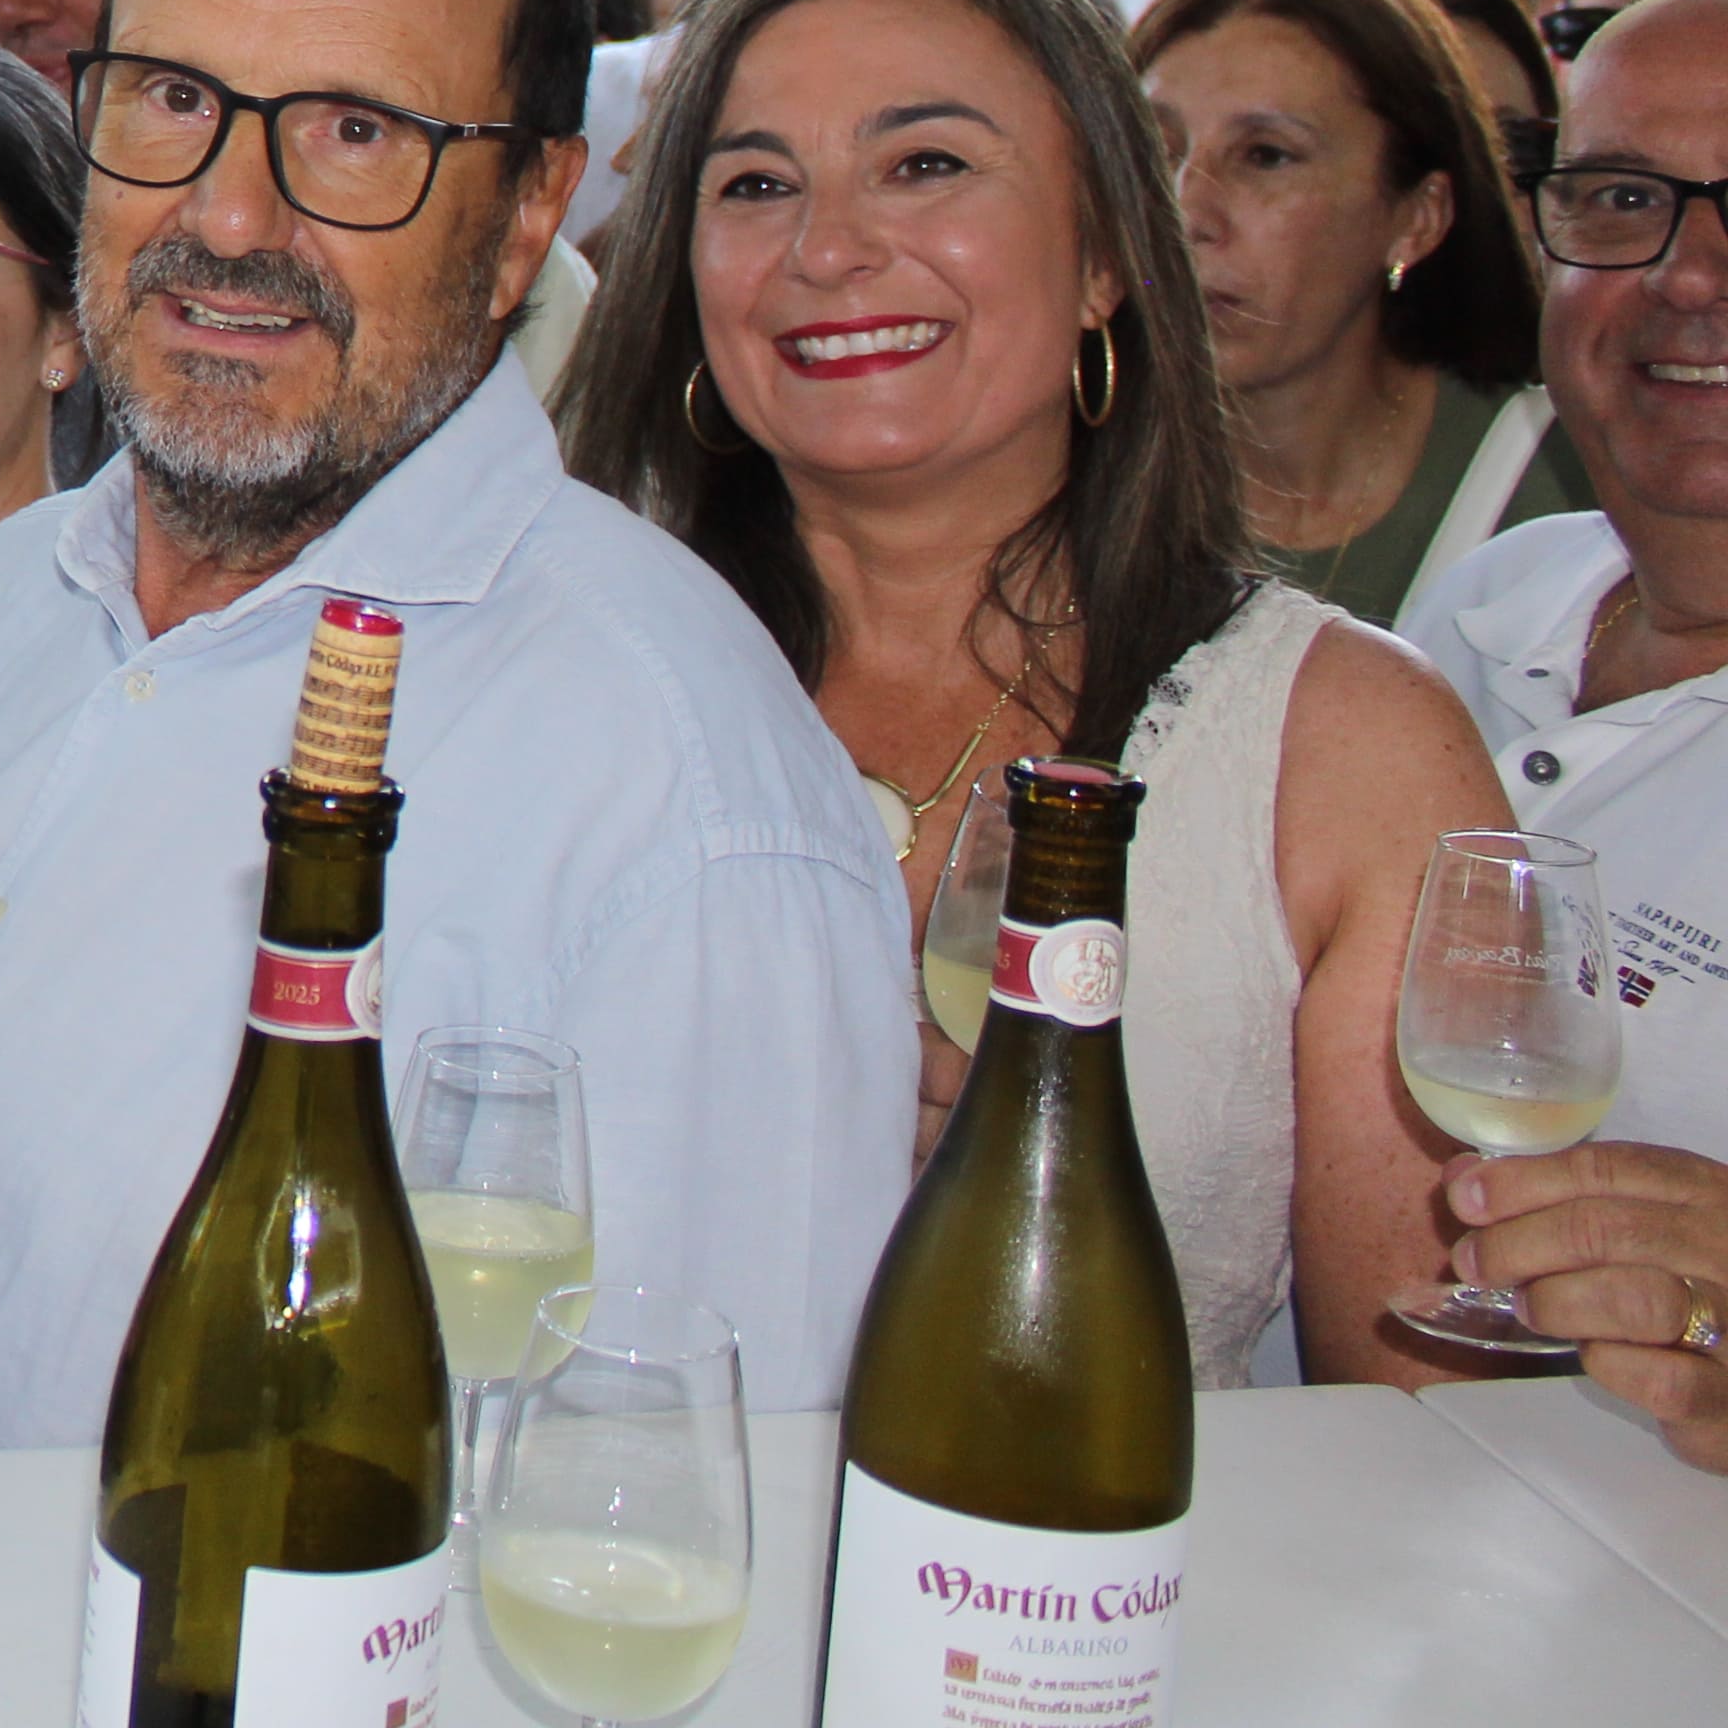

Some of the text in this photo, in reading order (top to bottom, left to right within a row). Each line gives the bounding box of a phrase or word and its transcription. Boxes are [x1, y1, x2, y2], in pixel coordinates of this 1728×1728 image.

[274, 983, 320, 1005] 2025
[917, 1561, 1077, 1622] Martín
[1008, 1634, 1129, 1658] ALBARIÑO
